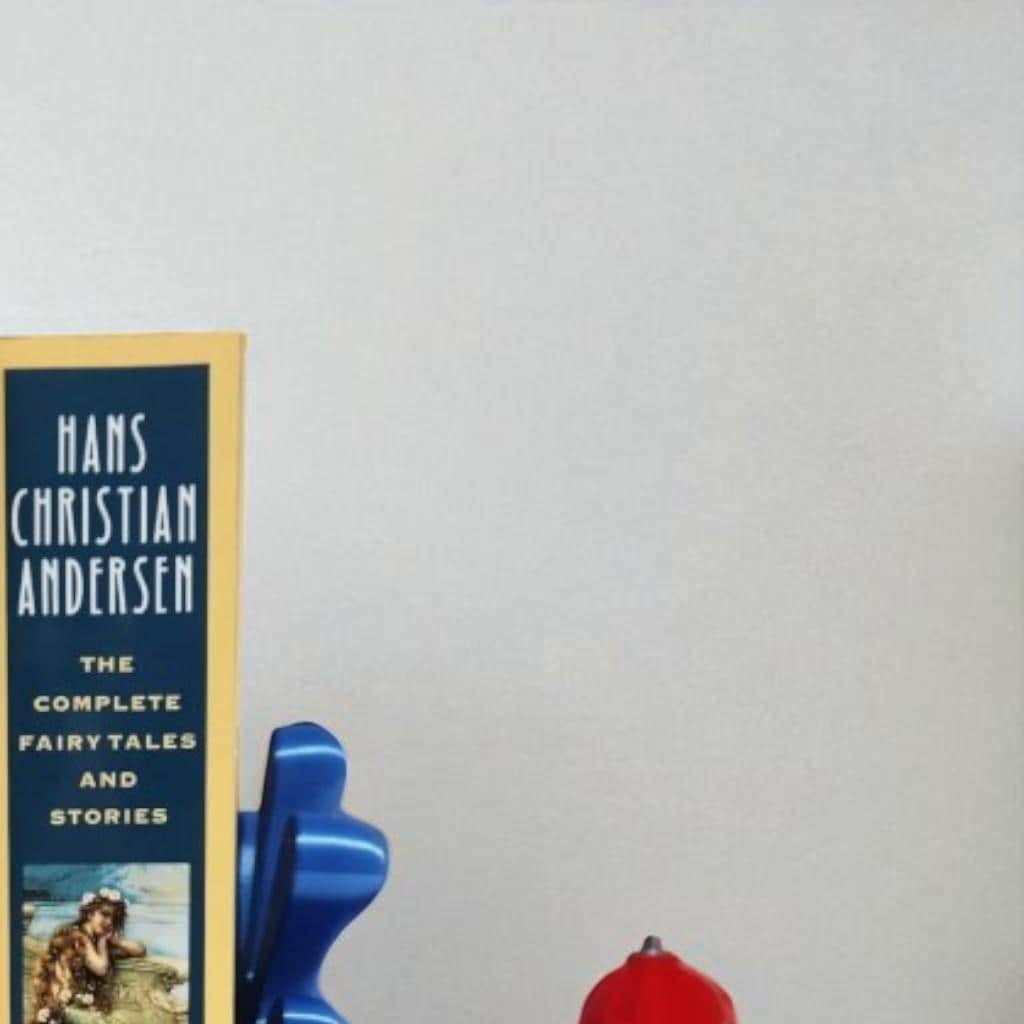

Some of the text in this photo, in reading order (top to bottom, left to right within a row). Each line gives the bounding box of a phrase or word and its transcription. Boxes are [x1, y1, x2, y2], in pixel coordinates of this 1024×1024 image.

[57, 412, 147, 475] HANS
[11, 483, 198, 547] CHRISTIAN
[17, 554, 193, 617] ANDERSEN
[79, 656, 135, 674] THE
[32, 694, 183, 713] COMPLETE
[18, 732, 198, 752] FAIRY TALES
[79, 770, 139, 789] AND
[49, 807, 169, 827] STORIES
